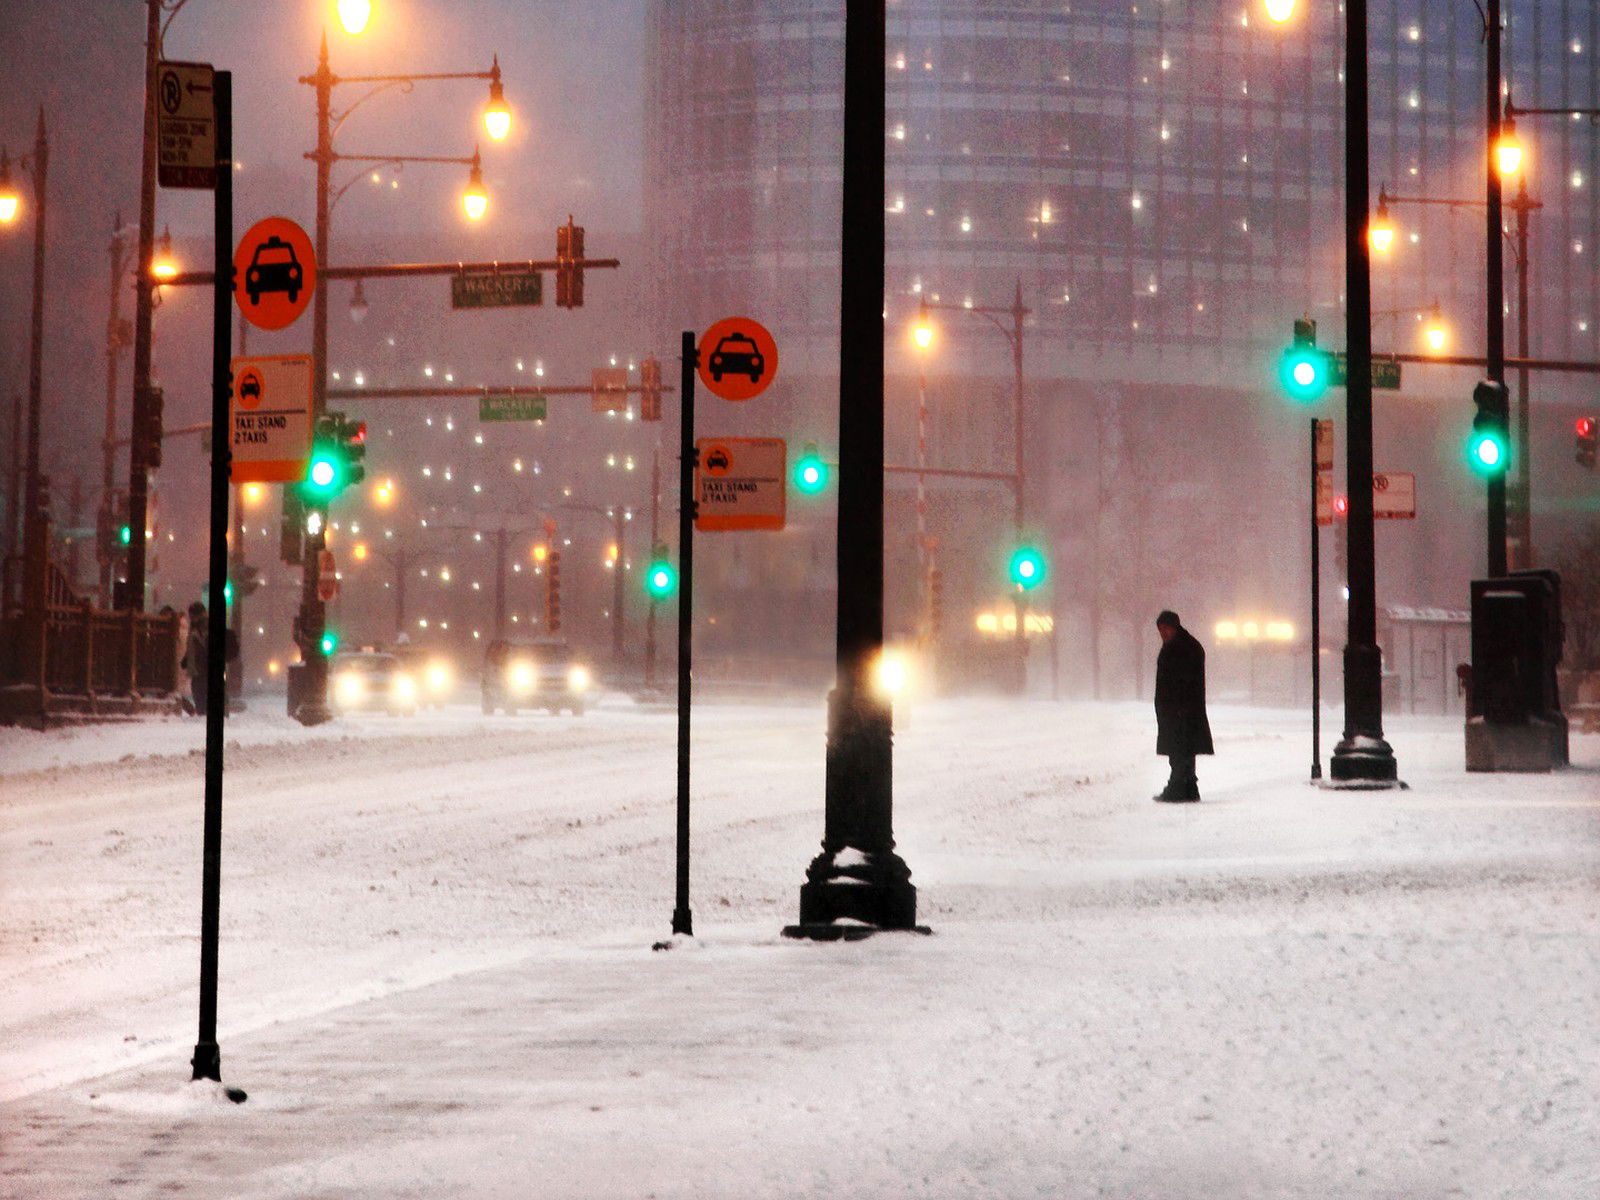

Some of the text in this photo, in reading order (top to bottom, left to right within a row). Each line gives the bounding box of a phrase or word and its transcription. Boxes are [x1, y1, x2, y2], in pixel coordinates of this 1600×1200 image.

[464, 277, 521, 292] WACKER
[236, 416, 286, 429] TAXI STAND
[235, 431, 268, 444] 2 TAXIS
[702, 481, 758, 493] TAXI STAND
[702, 493, 737, 503] 2 TAXIS
